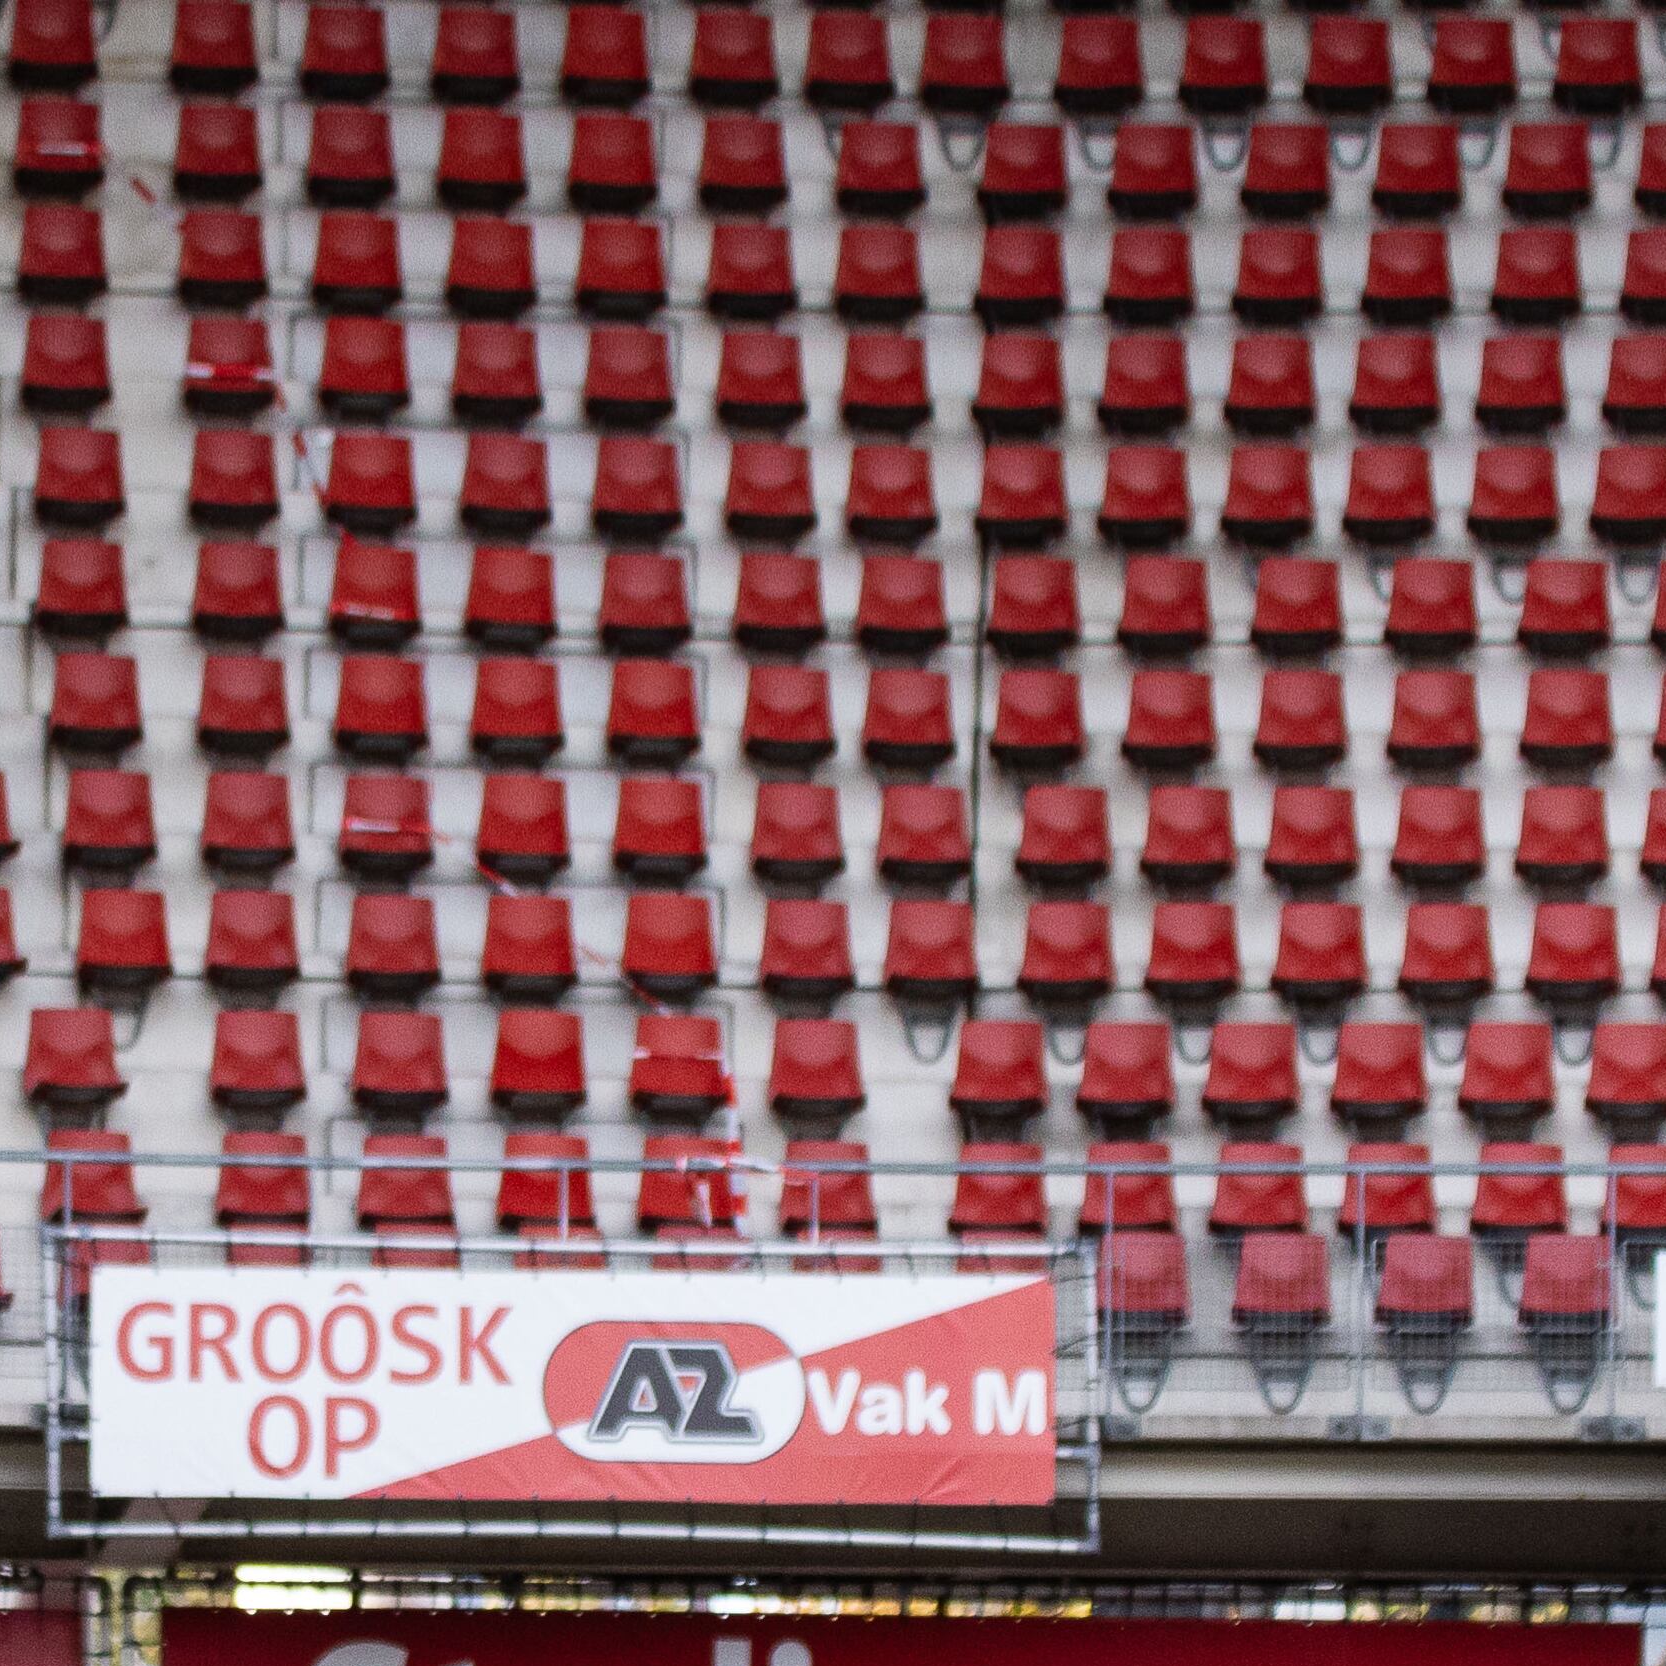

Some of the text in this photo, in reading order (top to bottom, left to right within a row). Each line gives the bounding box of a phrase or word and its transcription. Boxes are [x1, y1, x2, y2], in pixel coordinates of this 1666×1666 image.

[116, 1282, 513, 1386] GROÔSK
[247, 1394, 382, 1481] OP
[587, 1338, 763, 1444] AZ
[808, 1368, 1047, 1439] Vak M
